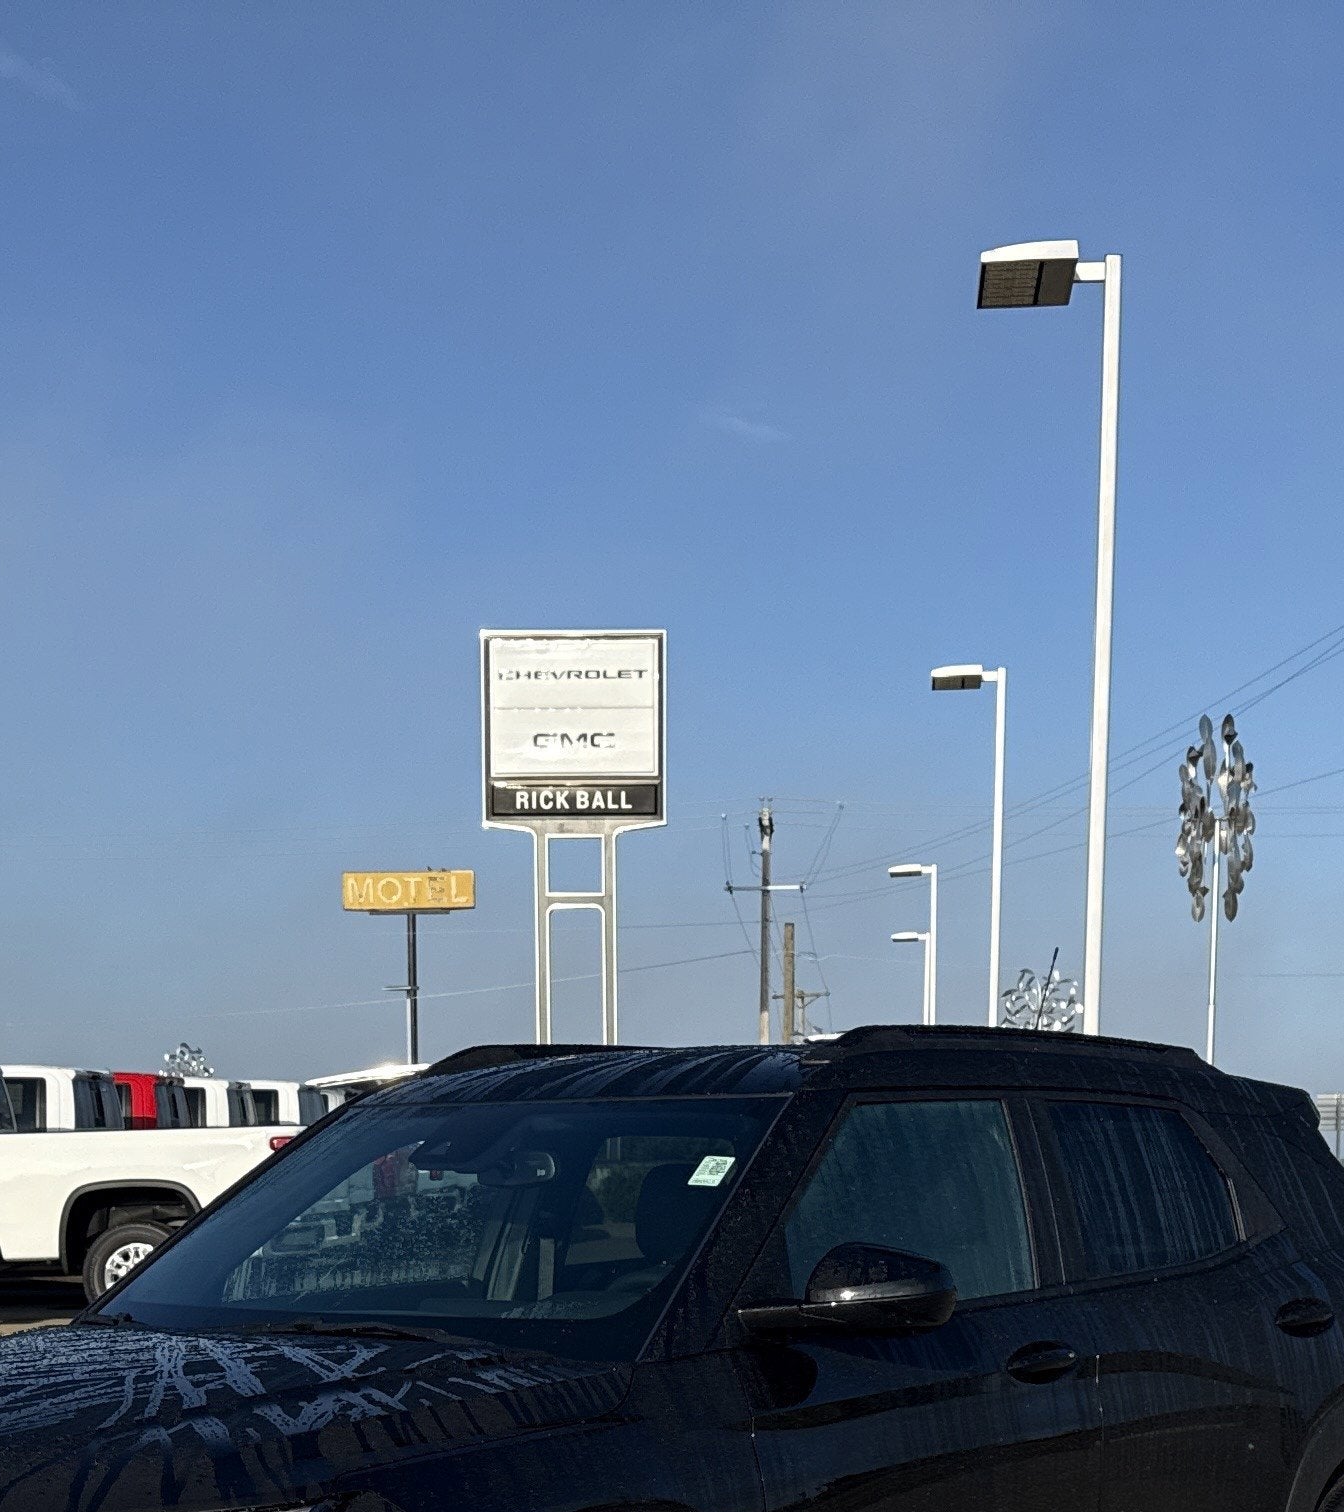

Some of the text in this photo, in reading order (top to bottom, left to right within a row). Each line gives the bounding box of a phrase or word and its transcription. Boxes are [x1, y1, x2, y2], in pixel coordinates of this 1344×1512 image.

[533, 732, 616, 748] GMC
[515, 790, 633, 810] RICK BALL
[347, 876, 469, 904] MOTEL
